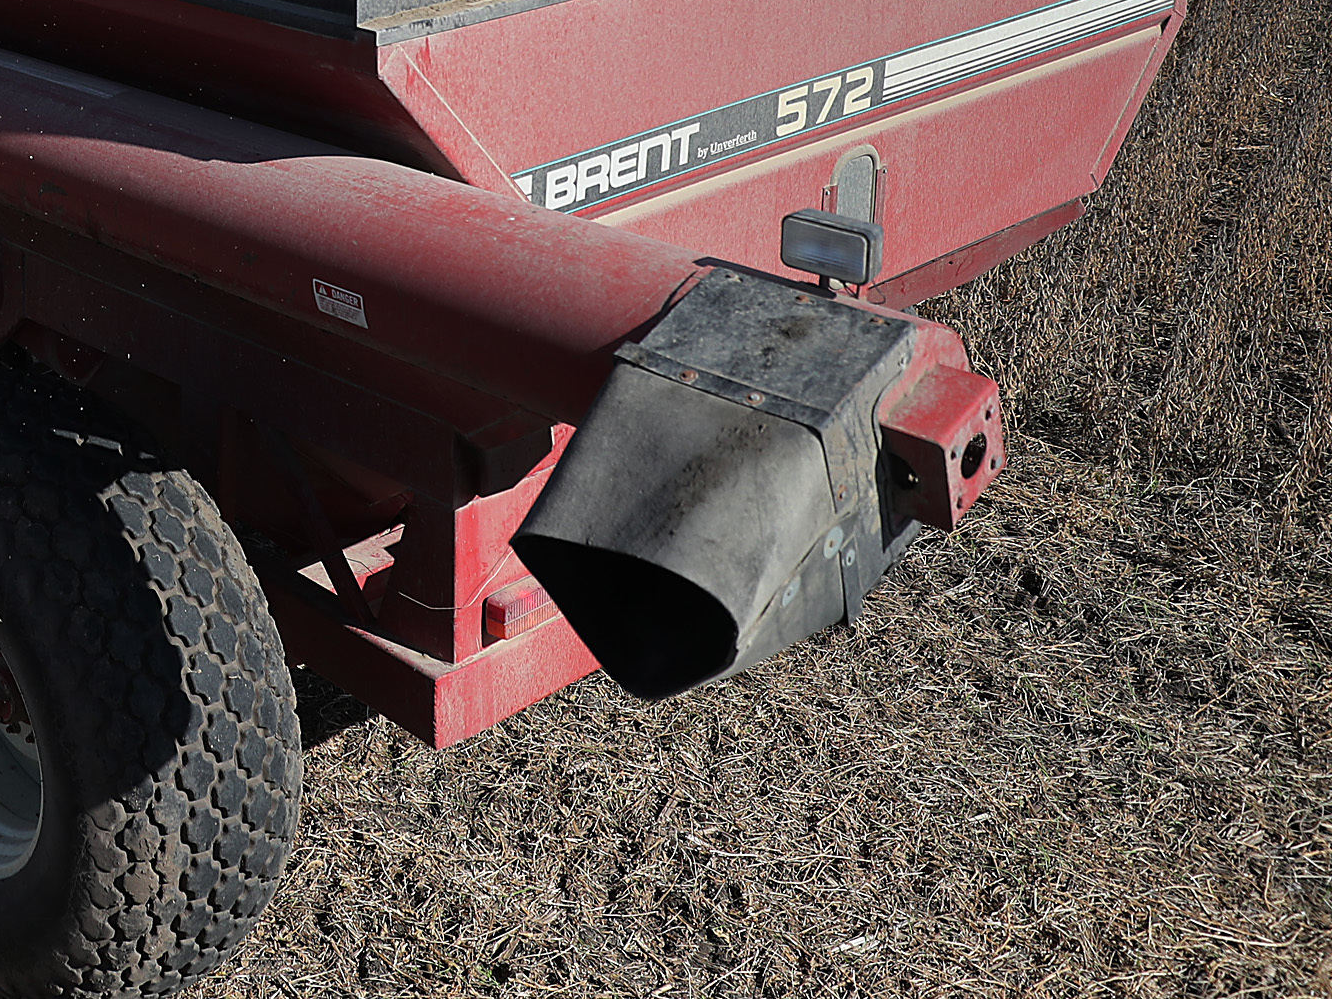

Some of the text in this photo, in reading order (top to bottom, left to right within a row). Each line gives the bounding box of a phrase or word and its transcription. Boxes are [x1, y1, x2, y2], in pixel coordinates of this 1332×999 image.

[545, 66, 874, 210] BRENT by Unverferth 572
[331, 289, 359, 307] DANGER
